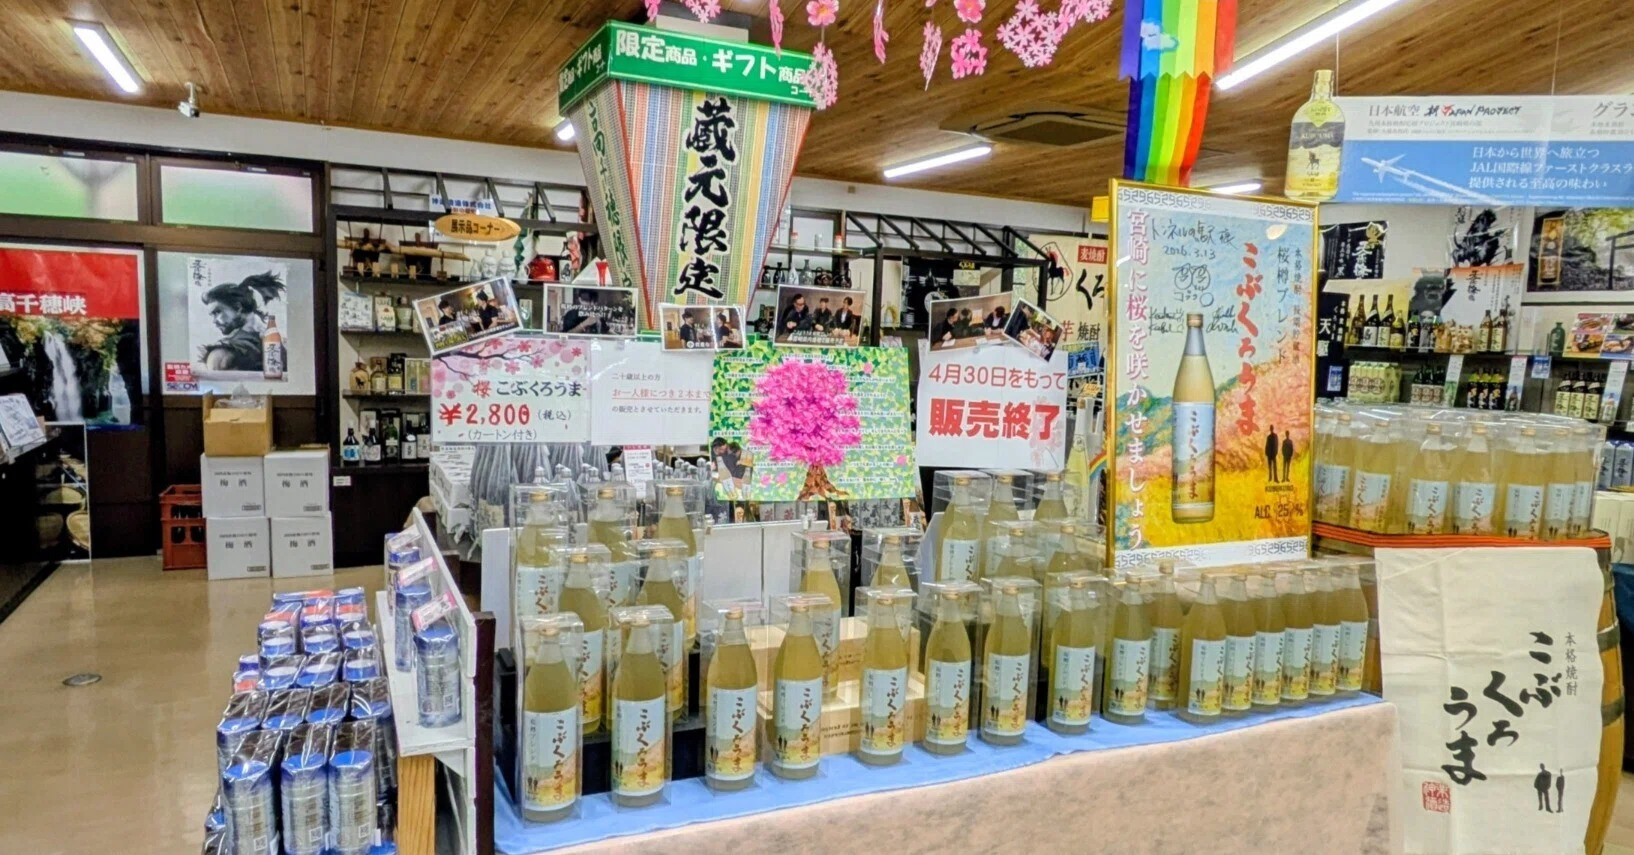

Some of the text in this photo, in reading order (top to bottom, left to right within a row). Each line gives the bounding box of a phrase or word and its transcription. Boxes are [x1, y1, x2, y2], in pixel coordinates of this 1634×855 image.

[1368, 104, 1421, 117] 日本航空
[1475, 104, 1522, 117] PROJECT
[1592, 101, 1634, 118] グラ
[1472, 146, 1601, 159] 日本から世界へ旅立つ
[674, 97, 736, 299] 蔵元限定
[1469, 177, 1608, 190] 提供される至高の味わい
[451, 219, 500, 235] 展示品コーナー
[1080, 248, 1106, 263] 麦焼酎
[0, 293, 87, 316] 高千穂峡
[1277, 246, 1290, 364] 桜樽ブレンド
[1235, 242, 1264, 436] こぶくろうま
[473, 380, 583, 398] 桜 こぶくろうま
[612, 373, 661, 381] 二十歳以上の方
[612, 388, 711, 398] お一人様につき2本まで
[928, 363, 1066, 390] 4月30日をもって
[1126, 209, 1150, 550] 宮崎に桜を咲かせましょう
[439, 403, 572, 427] ¥2,800 (税込)
[467, 430, 538, 441] (カートン付き)
[612, 405, 703, 414] の販売とさせていただきます。
[928, 397, 1062, 441] 販売終了
[1188, 410, 1200, 500] こぶくろうま
[1080, 653, 1091, 719] こぶくろうま
[1134, 647, 1146, 710] こぶくろうま
[1565, 631, 1579, 697] 本格焼酎
[886, 677, 899, 748] こぶくろうま
[953, 668, 965, 737] こぶくろうま
[1012, 662, 1023, 729] こぶくろうま
[636, 708, 651, 788] こぶくろうま
[731, 697, 746, 773] こぶくろうま
[799, 687, 813, 760] こぶくろうま
[552, 719, 567, 801] こぶくろうま
